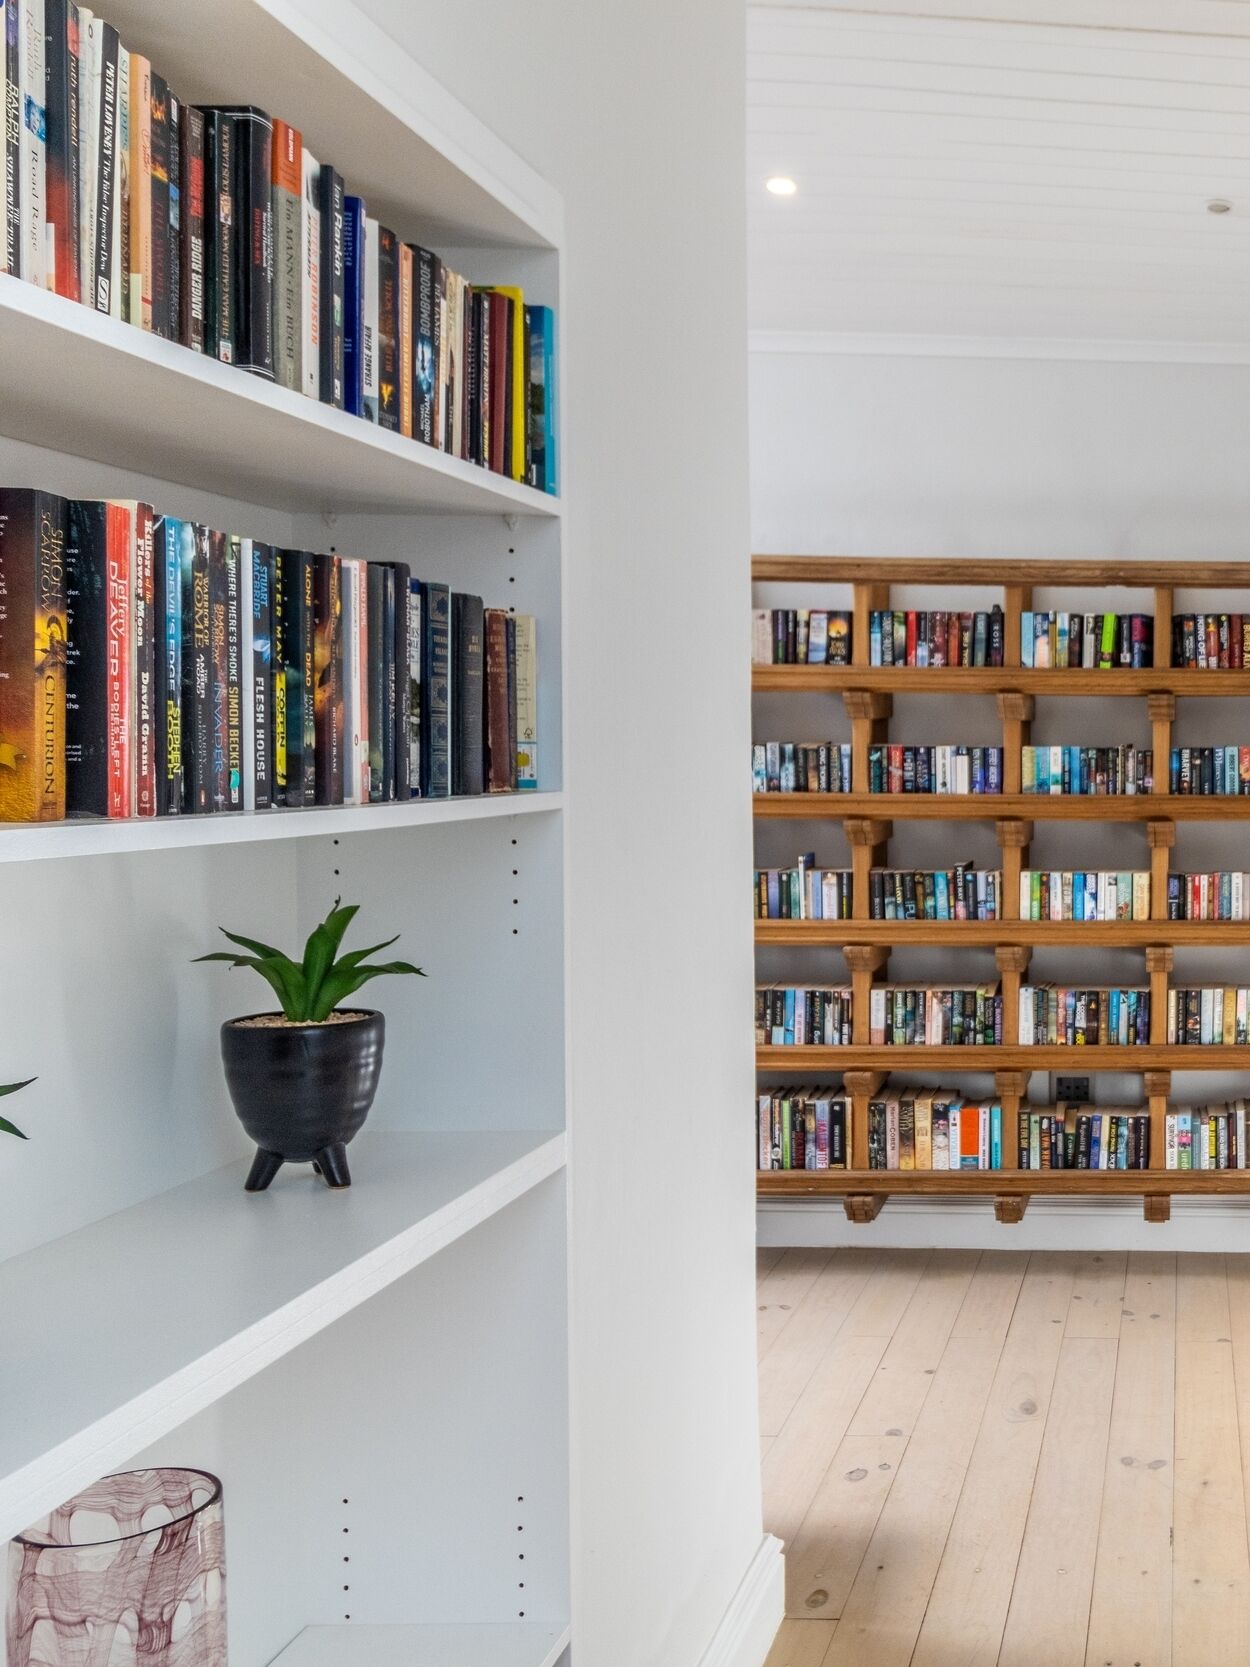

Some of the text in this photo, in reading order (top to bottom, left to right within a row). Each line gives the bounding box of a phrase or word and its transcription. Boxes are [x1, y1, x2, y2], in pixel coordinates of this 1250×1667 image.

[69, 55, 79, 147] ruth rendell
[105, 61, 115, 104] PETER
[30, 150, 38, 198] Road
[191, 236, 203, 320] DANGER RIDGE
[333, 212, 343, 277] Rankin
[420, 263, 431, 337] BOMBPROOF
[41, 509, 51, 613] SCARROW
[51, 528, 64, 598] SIMON
[108, 560, 119, 676] DEAVER
[194, 571, 204, 649] ROME
[228, 600, 238, 644] THERE'S
[45, 675, 55, 795] CENTURION
[141, 671, 149, 777] David Grann
[213, 681, 224, 773] INVADER
[229, 686, 239, 726] SIMON
[256, 677, 266, 781] FLESH HOUSE
